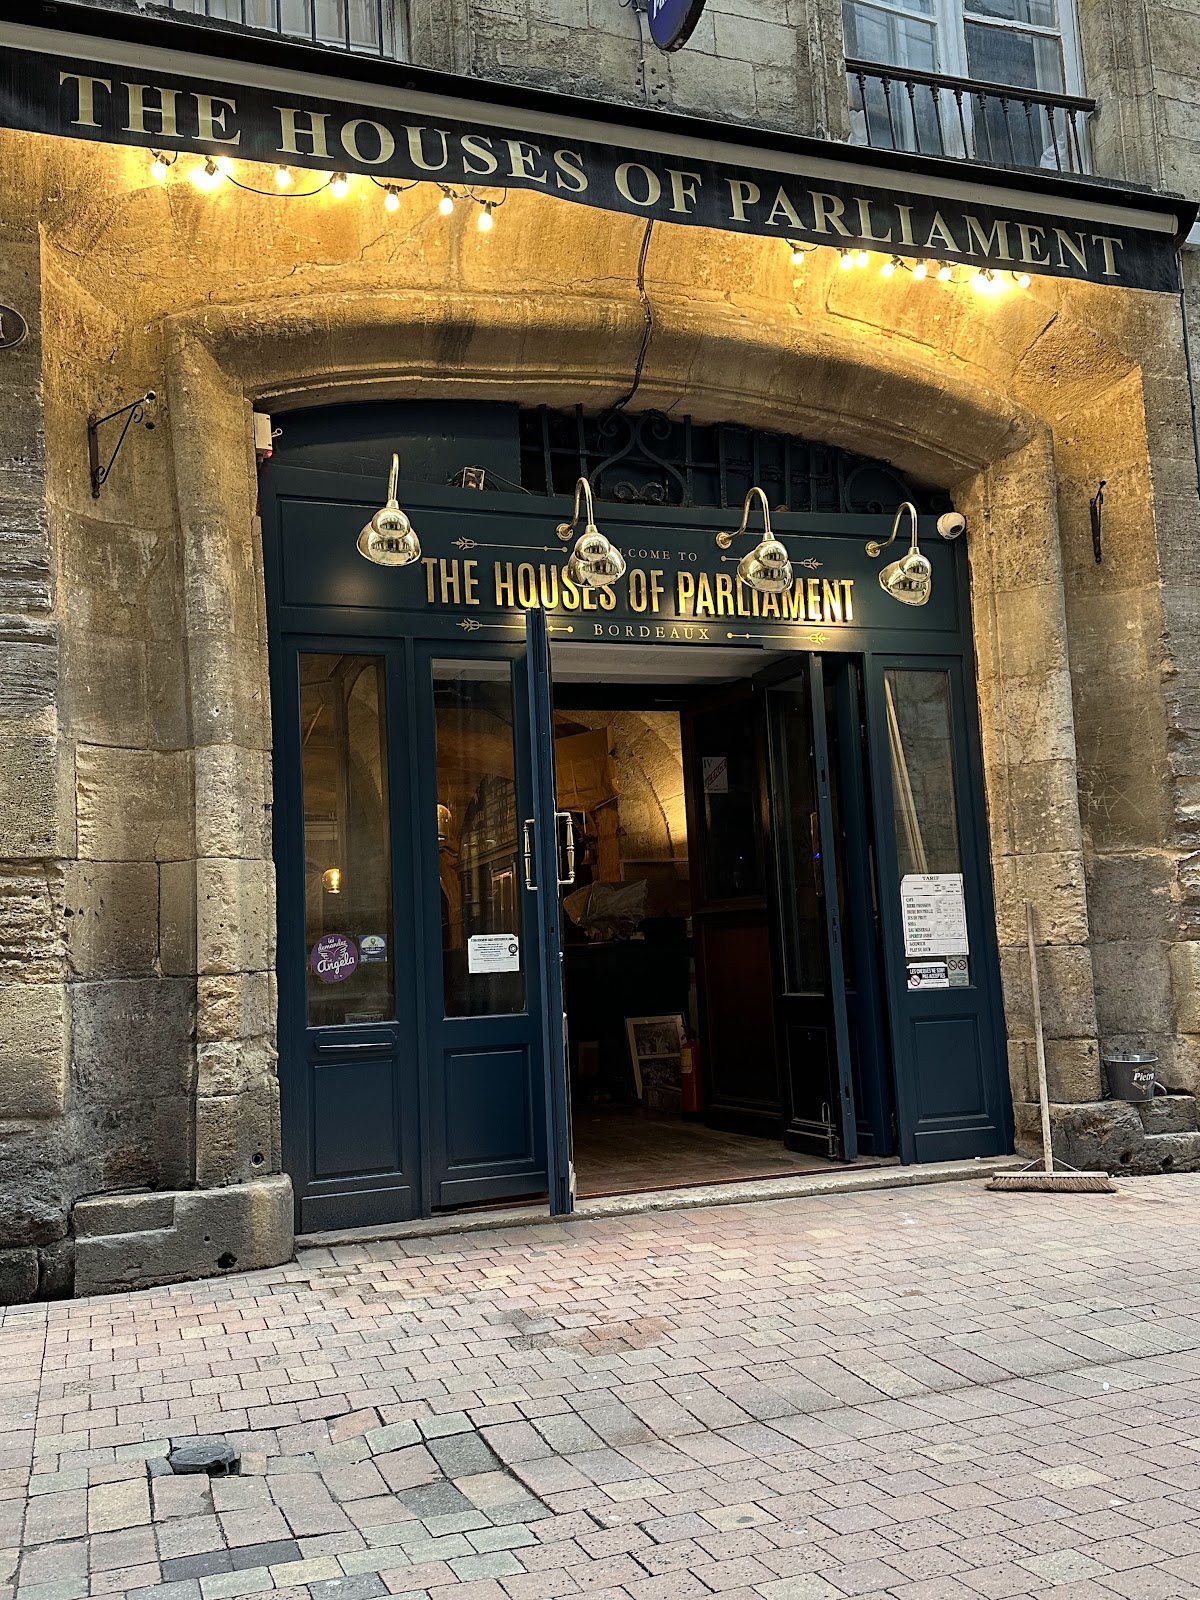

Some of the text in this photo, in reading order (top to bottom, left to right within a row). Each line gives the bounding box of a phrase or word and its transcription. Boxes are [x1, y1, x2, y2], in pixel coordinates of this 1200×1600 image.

[60, 71, 1123, 276] THE HOUSES OF PARLIAMENT
[678, 551, 698, 562] TO
[421, 557, 480, 605] THE
[494, 561, 617, 611] HOUSES
[629, 568, 665, 613] OF
[593, 623, 710, 640] BORDEAUX
[317, 938, 348, 952] demandez
[327, 936, 335, 944] ici
[317, 952, 355, 975] Angela
